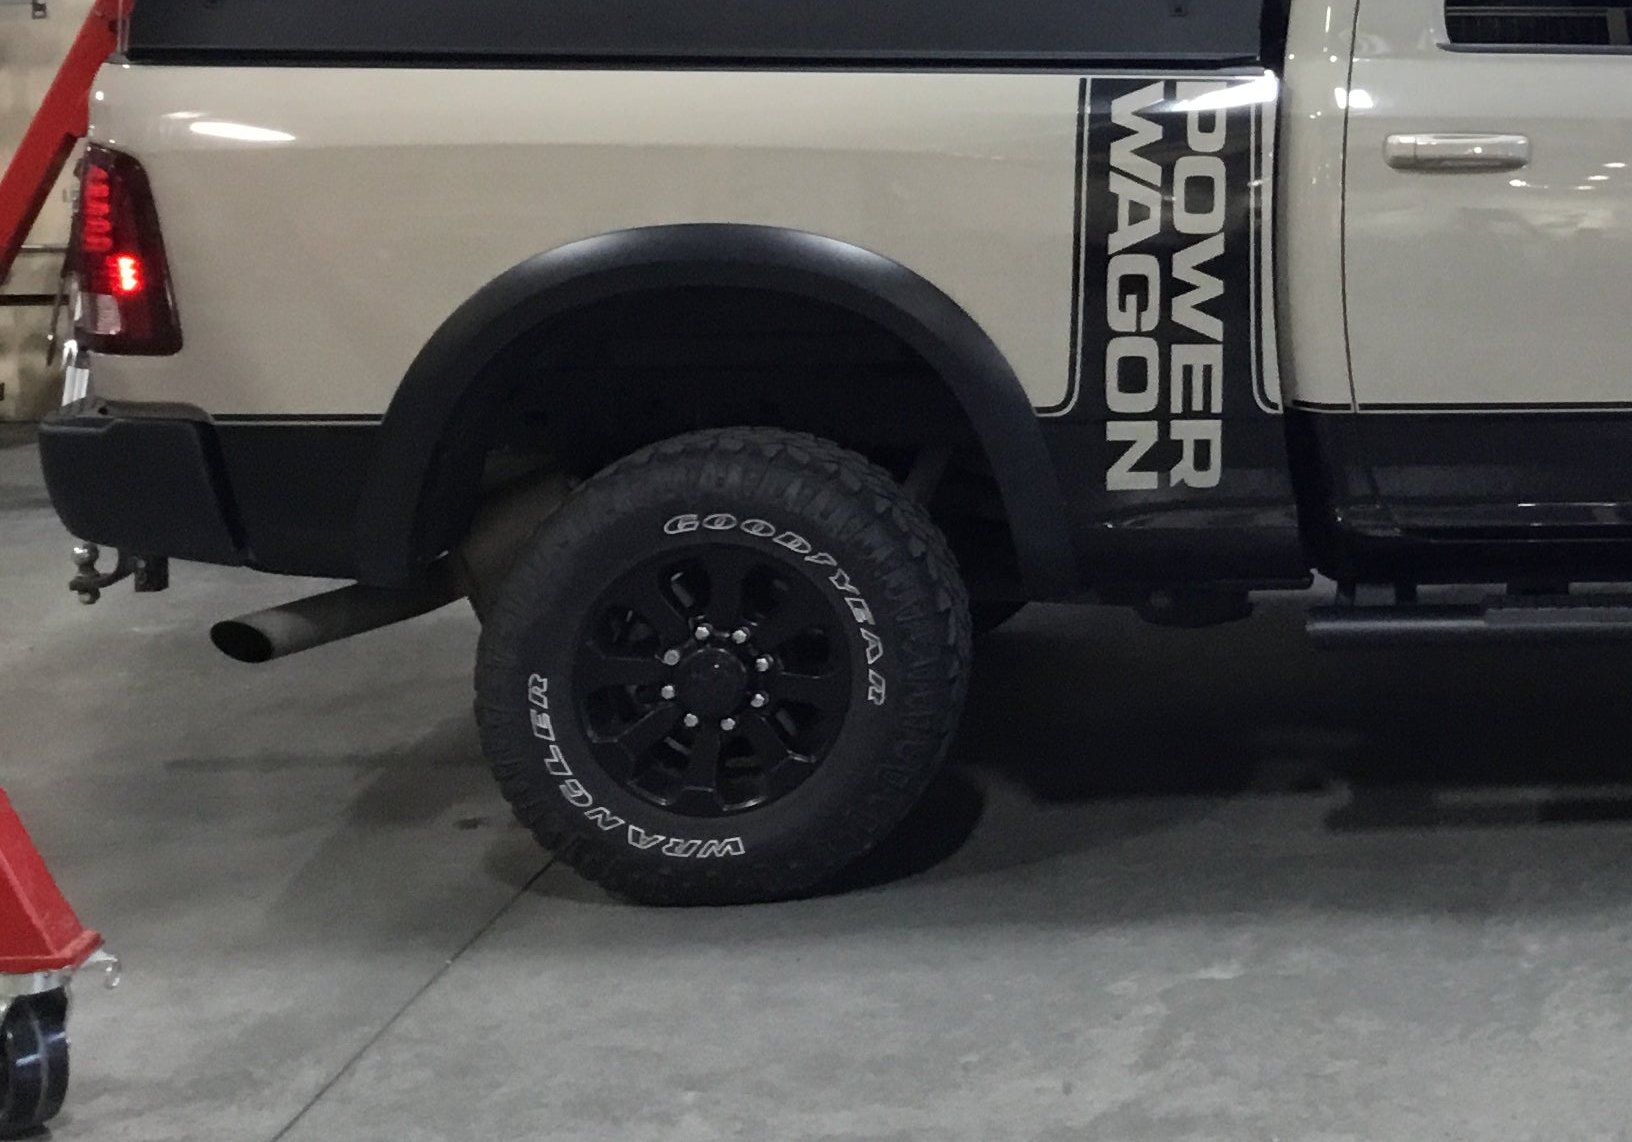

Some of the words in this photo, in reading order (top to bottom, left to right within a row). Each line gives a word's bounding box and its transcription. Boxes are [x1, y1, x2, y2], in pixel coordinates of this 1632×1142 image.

[1105, 81, 1165, 491] WAGON
[1169, 81, 1227, 489] POWER
[664, 513, 886, 705] GOODYEAR
[528, 673, 745, 858] WRANGLER
